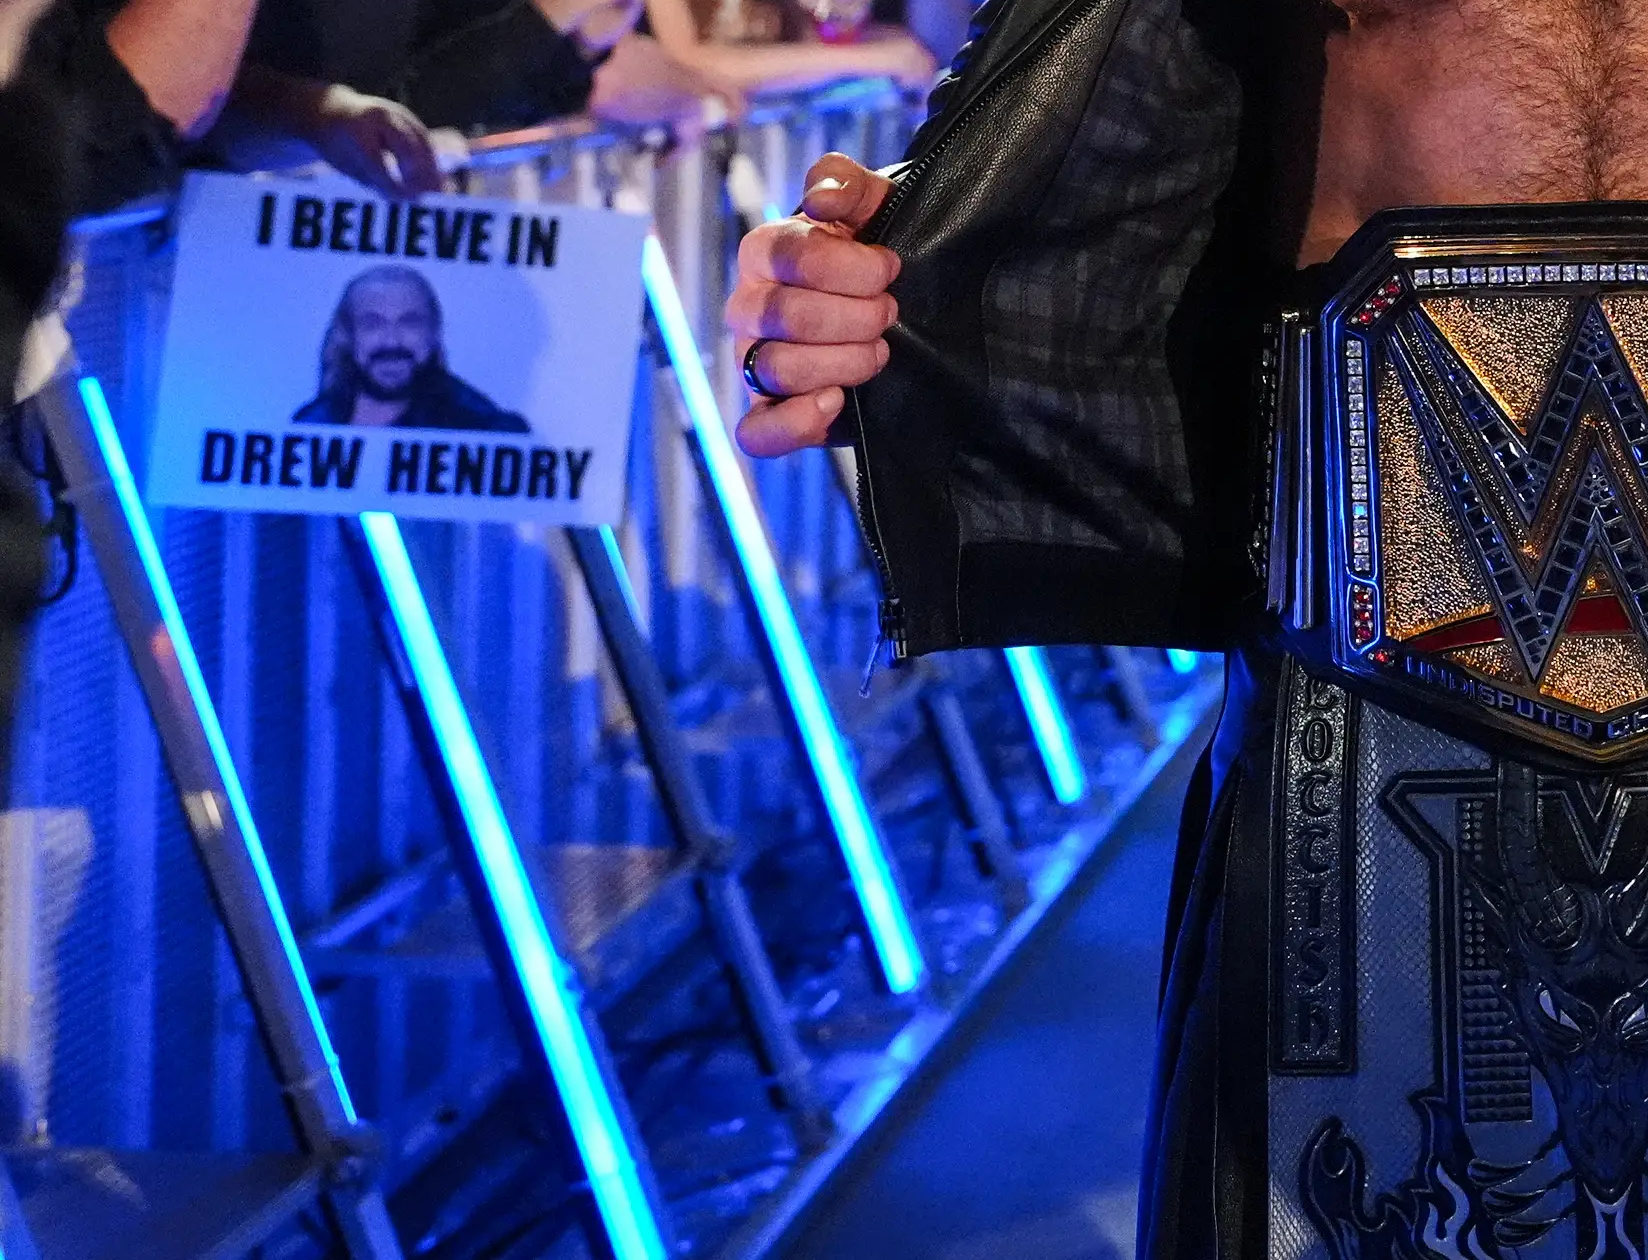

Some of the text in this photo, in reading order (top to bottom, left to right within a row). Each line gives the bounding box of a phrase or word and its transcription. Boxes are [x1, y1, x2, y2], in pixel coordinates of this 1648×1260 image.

[256, 191, 561, 269] I BELIEVE IN
[200, 429, 594, 502] DREW HENDRY
[1406, 655, 1594, 740] UNDISPUTED
